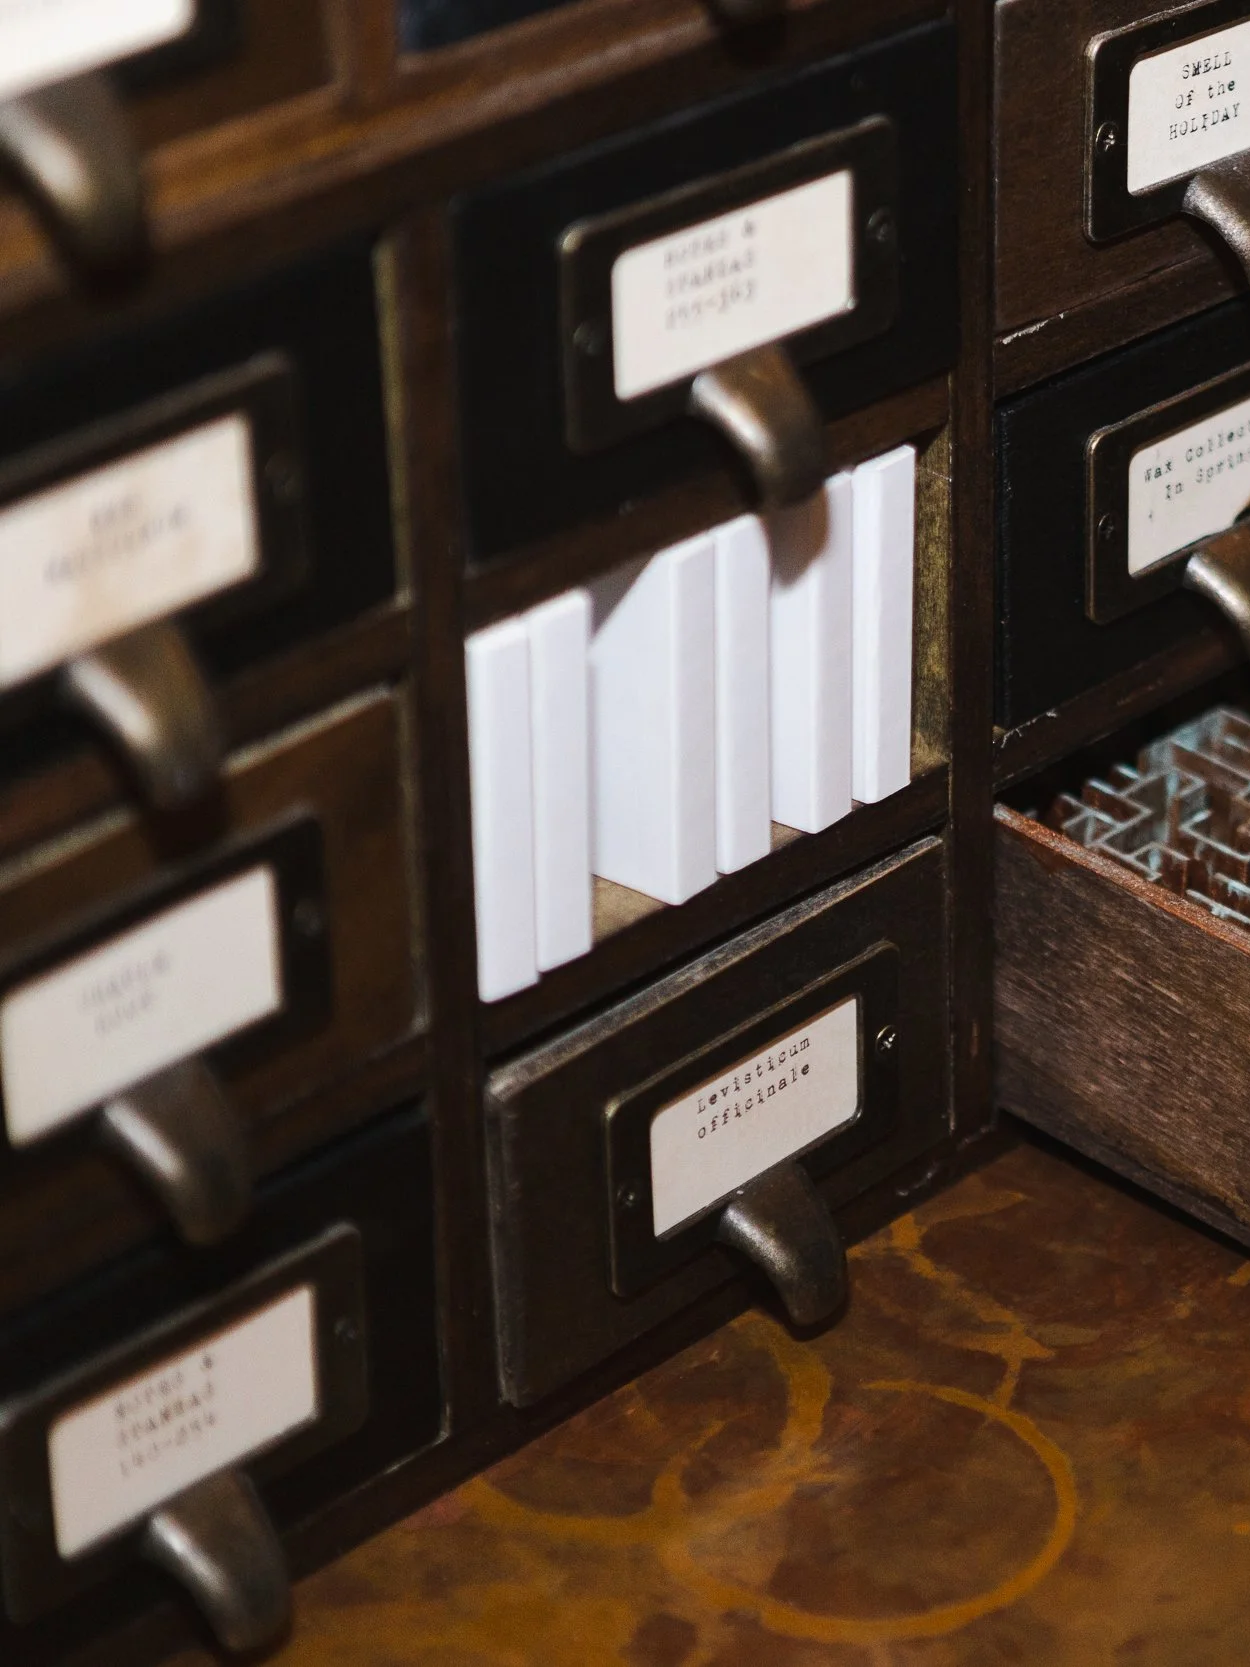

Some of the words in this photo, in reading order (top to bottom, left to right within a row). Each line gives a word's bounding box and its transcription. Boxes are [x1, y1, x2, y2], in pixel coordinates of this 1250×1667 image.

[1182, 51, 1232, 80] SMELL
[1208, 79, 1236, 100] the
[1169, 103, 1240, 140] HOLIDAY
[1144, 460, 1173, 483] Wax
[696, 1036, 811, 1114] Levisticum
[697, 1063, 810, 1139] officinale
